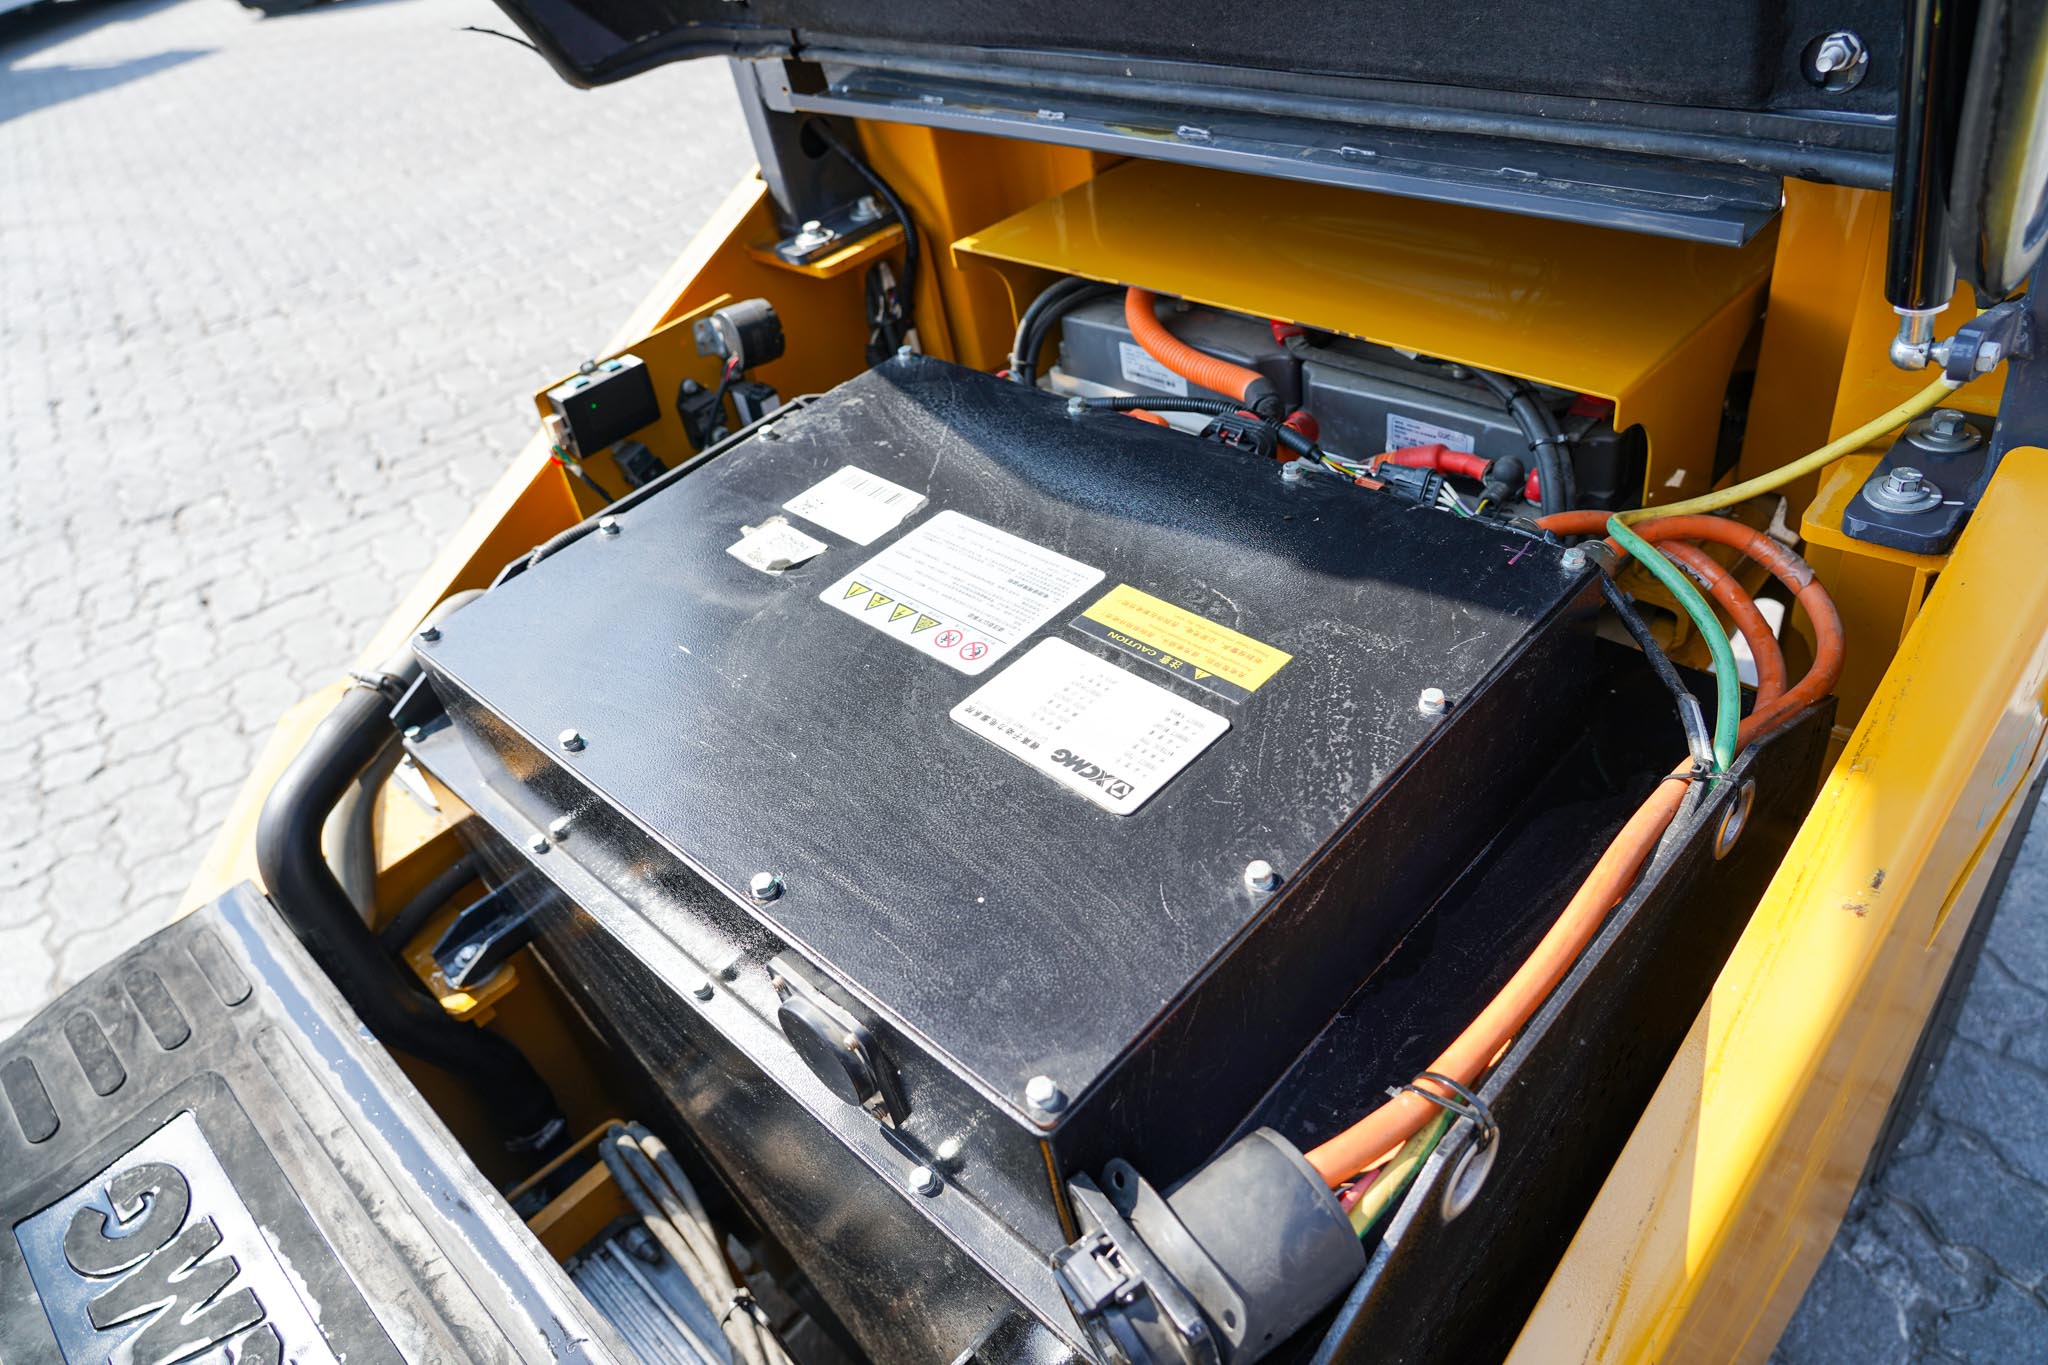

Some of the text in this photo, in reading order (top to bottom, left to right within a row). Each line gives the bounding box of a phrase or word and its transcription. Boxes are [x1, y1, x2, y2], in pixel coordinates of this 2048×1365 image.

[1107, 631, 1157, 657] CAUTION
[1159, 654, 1183, 670] 注意
[1050, 748, 1117, 787] XCMG
[63, 1162, 298, 1365] MG
